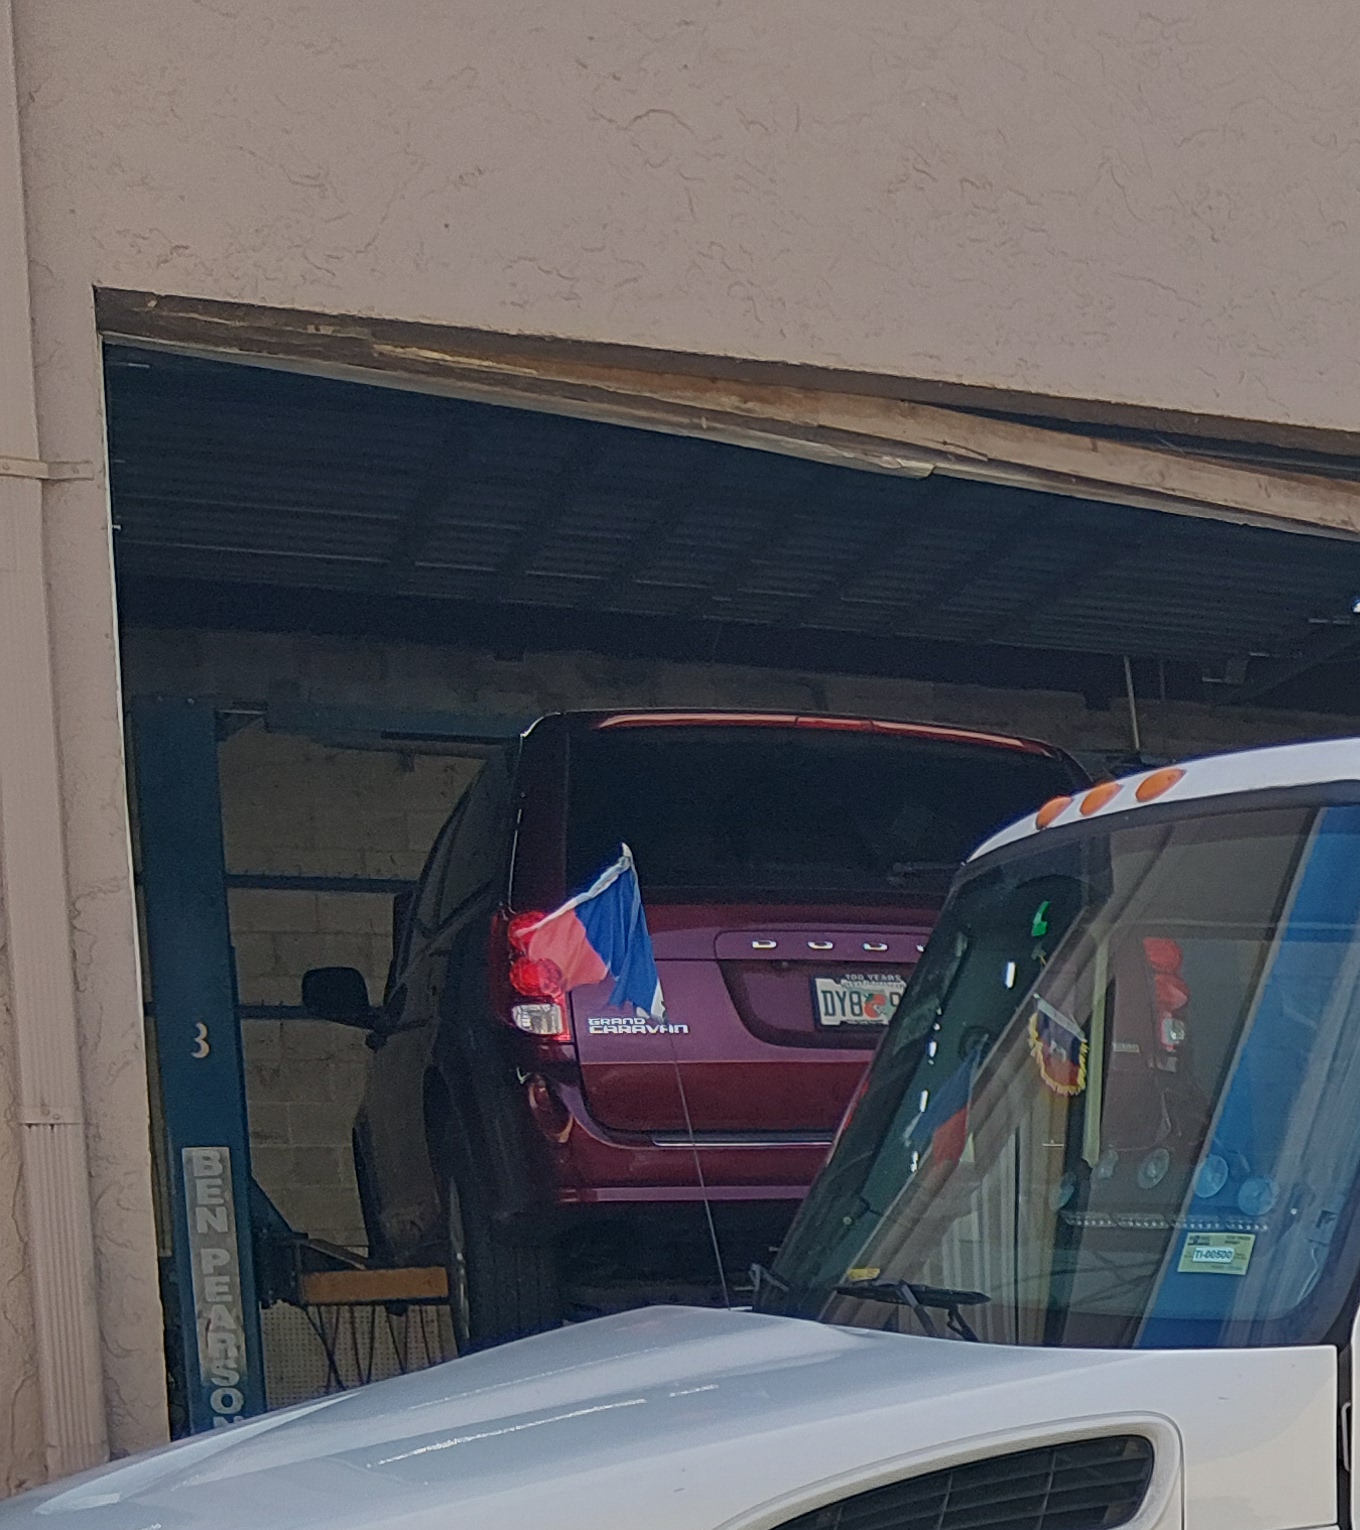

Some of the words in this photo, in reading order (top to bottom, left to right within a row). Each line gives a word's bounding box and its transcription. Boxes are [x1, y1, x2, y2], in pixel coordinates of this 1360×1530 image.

[752, 940, 924, 952] DOD
[588, 1017, 646, 1026] GRAND
[589, 1024, 689, 1034] CARAVAN
[190, 1023, 210, 1058] 3
[192, 1149, 229, 1235] BEN
